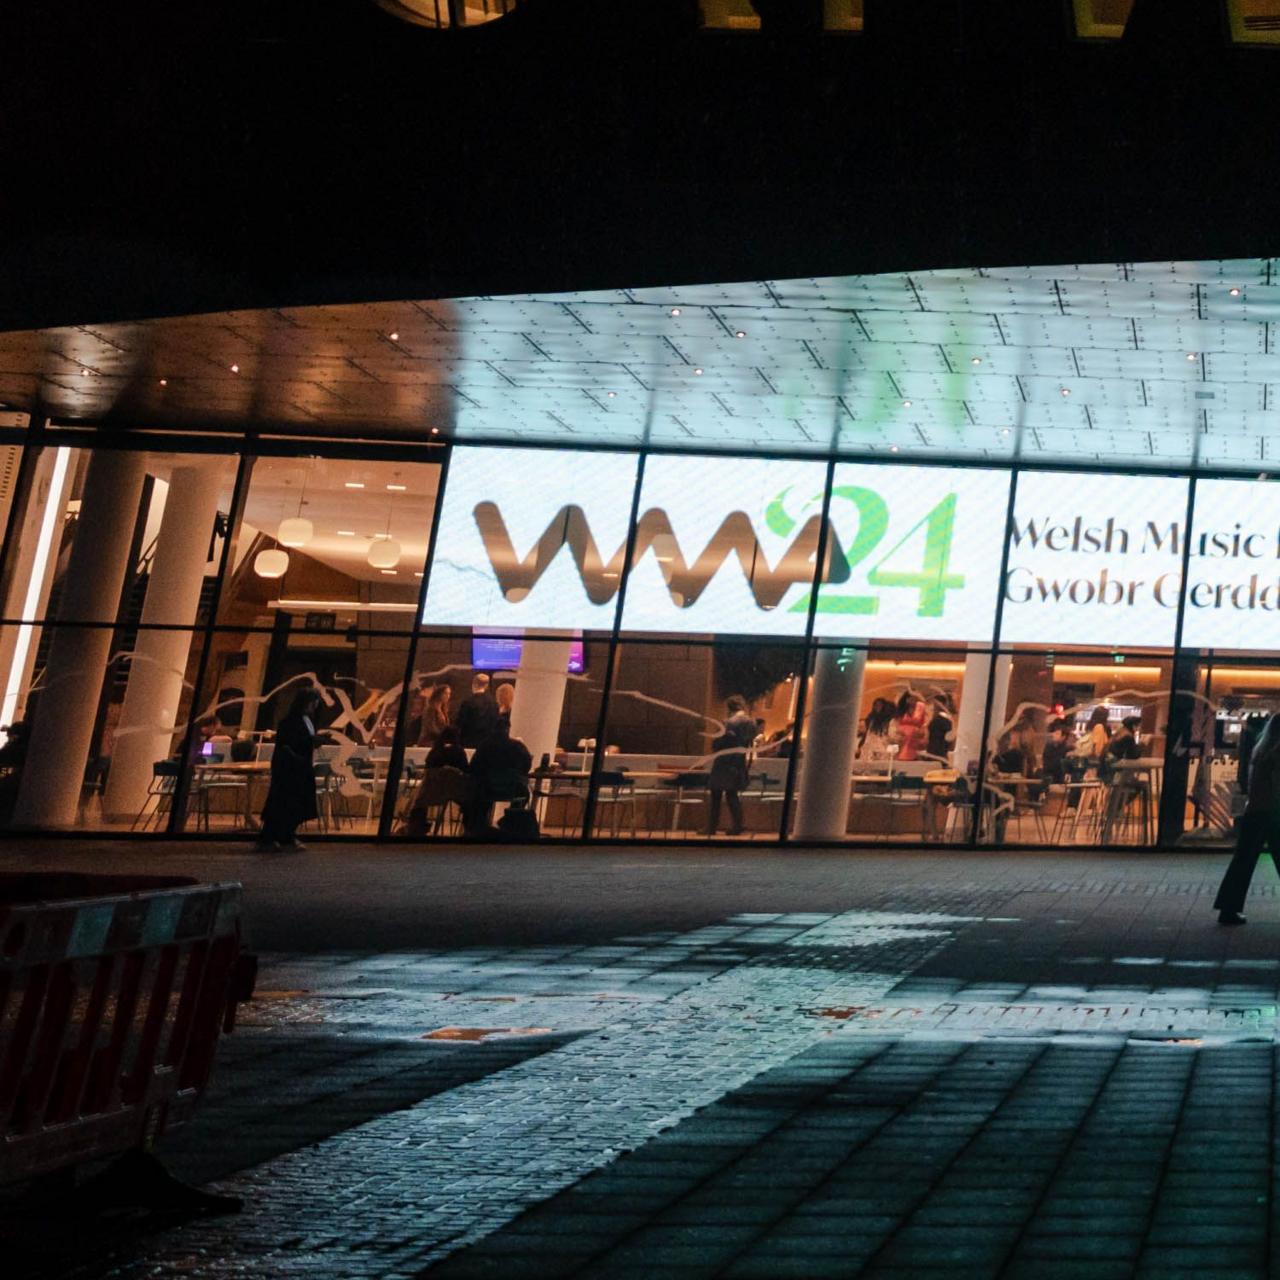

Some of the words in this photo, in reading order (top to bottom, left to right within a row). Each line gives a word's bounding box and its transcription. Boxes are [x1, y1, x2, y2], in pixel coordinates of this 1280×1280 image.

[1010, 515, 1129, 554] Welsh
[1142, 520, 1267, 558] Music
[1004, 567, 1144, 606] Gwobr
